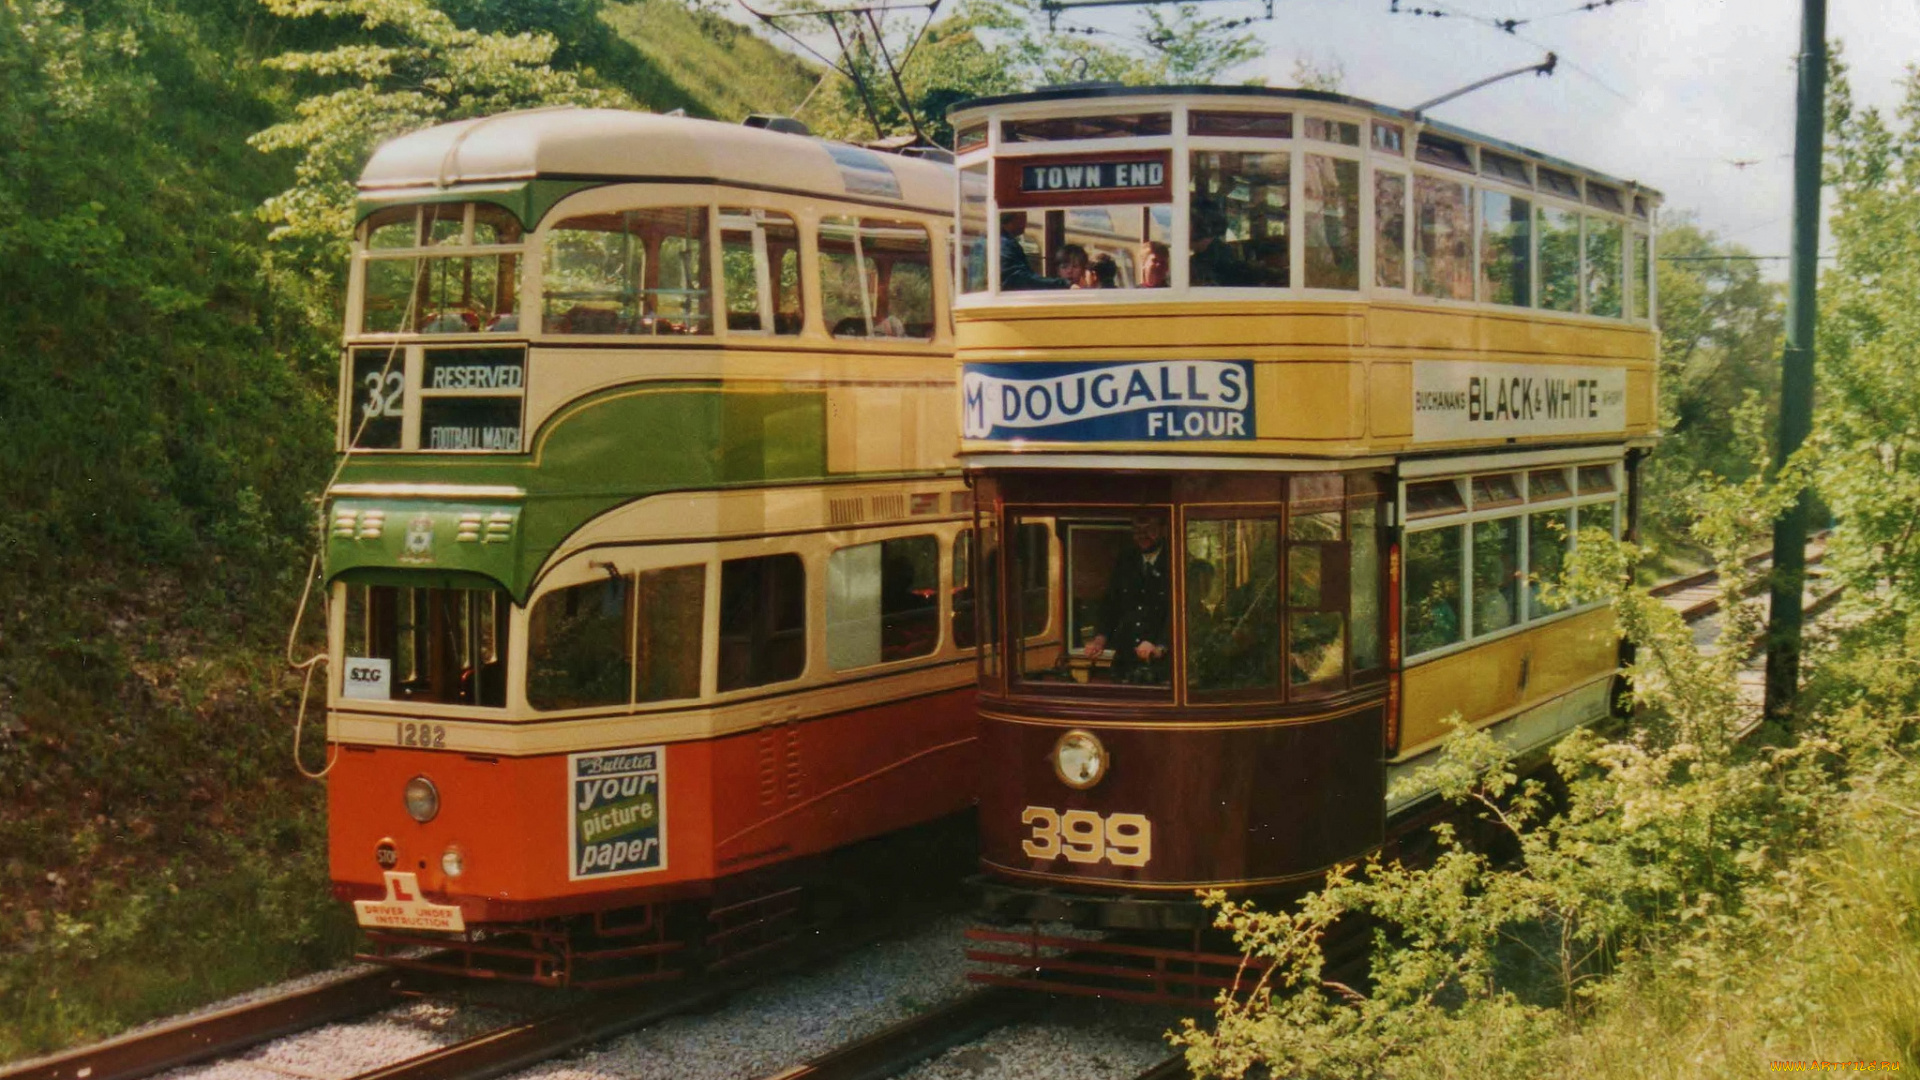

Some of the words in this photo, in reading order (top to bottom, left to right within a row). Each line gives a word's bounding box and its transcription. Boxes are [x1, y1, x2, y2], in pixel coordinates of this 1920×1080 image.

[1034, 165, 1100, 189] TOWN
[1115, 163, 1163, 186] END
[433, 366, 522, 388] RESERVED
[362, 371, 404, 417] 32
[1469, 376, 1534, 421] BLACK
[1545, 378, 1597, 419] WHITE
[1149, 411, 1245, 437] FLOUR
[430, 427, 479, 449] FOOTBALL
[482, 427, 519, 449] MATCH
[397, 722, 445, 748] 1282
[578, 775, 656, 811] your
[582, 803, 652, 842] picture
[1022, 806, 1151, 867] 399
[580, 837, 658, 874] paper
[392, 879, 413, 901] L
[364, 905, 404, 914] DRIVER
[416, 908, 453, 918] UNDER
[375, 916, 450, 927] INSTRUCTION
